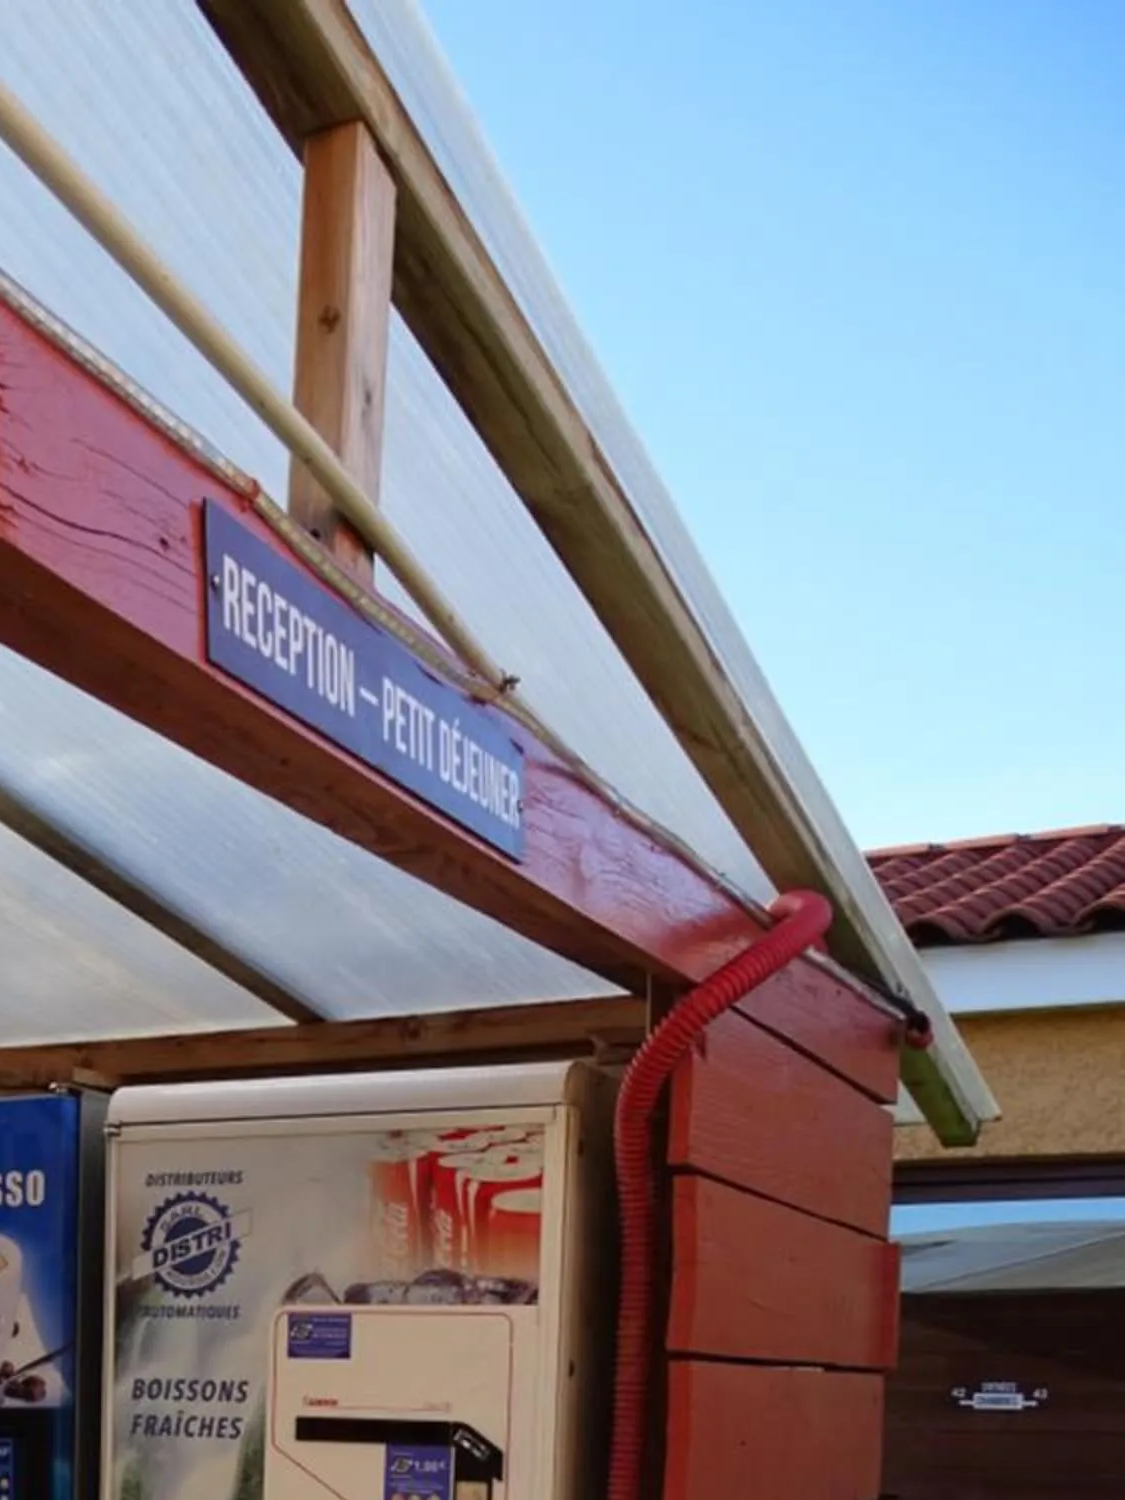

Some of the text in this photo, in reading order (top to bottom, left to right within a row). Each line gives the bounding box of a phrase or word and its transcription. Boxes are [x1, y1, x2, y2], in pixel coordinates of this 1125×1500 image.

[222, 553, 356, 718] RECEPTION
[382, 676, 436, 773] PETIT
[438, 718, 521, 830] DÉJEUNER
[144, 1170, 244, 1187] DISTRIBUTEURS
[152, 1221, 231, 1268] DISTRI
[140, 1303, 241, 1321] AUTOMATIQUES
[131, 1377, 250, 1404] BOISSONS
